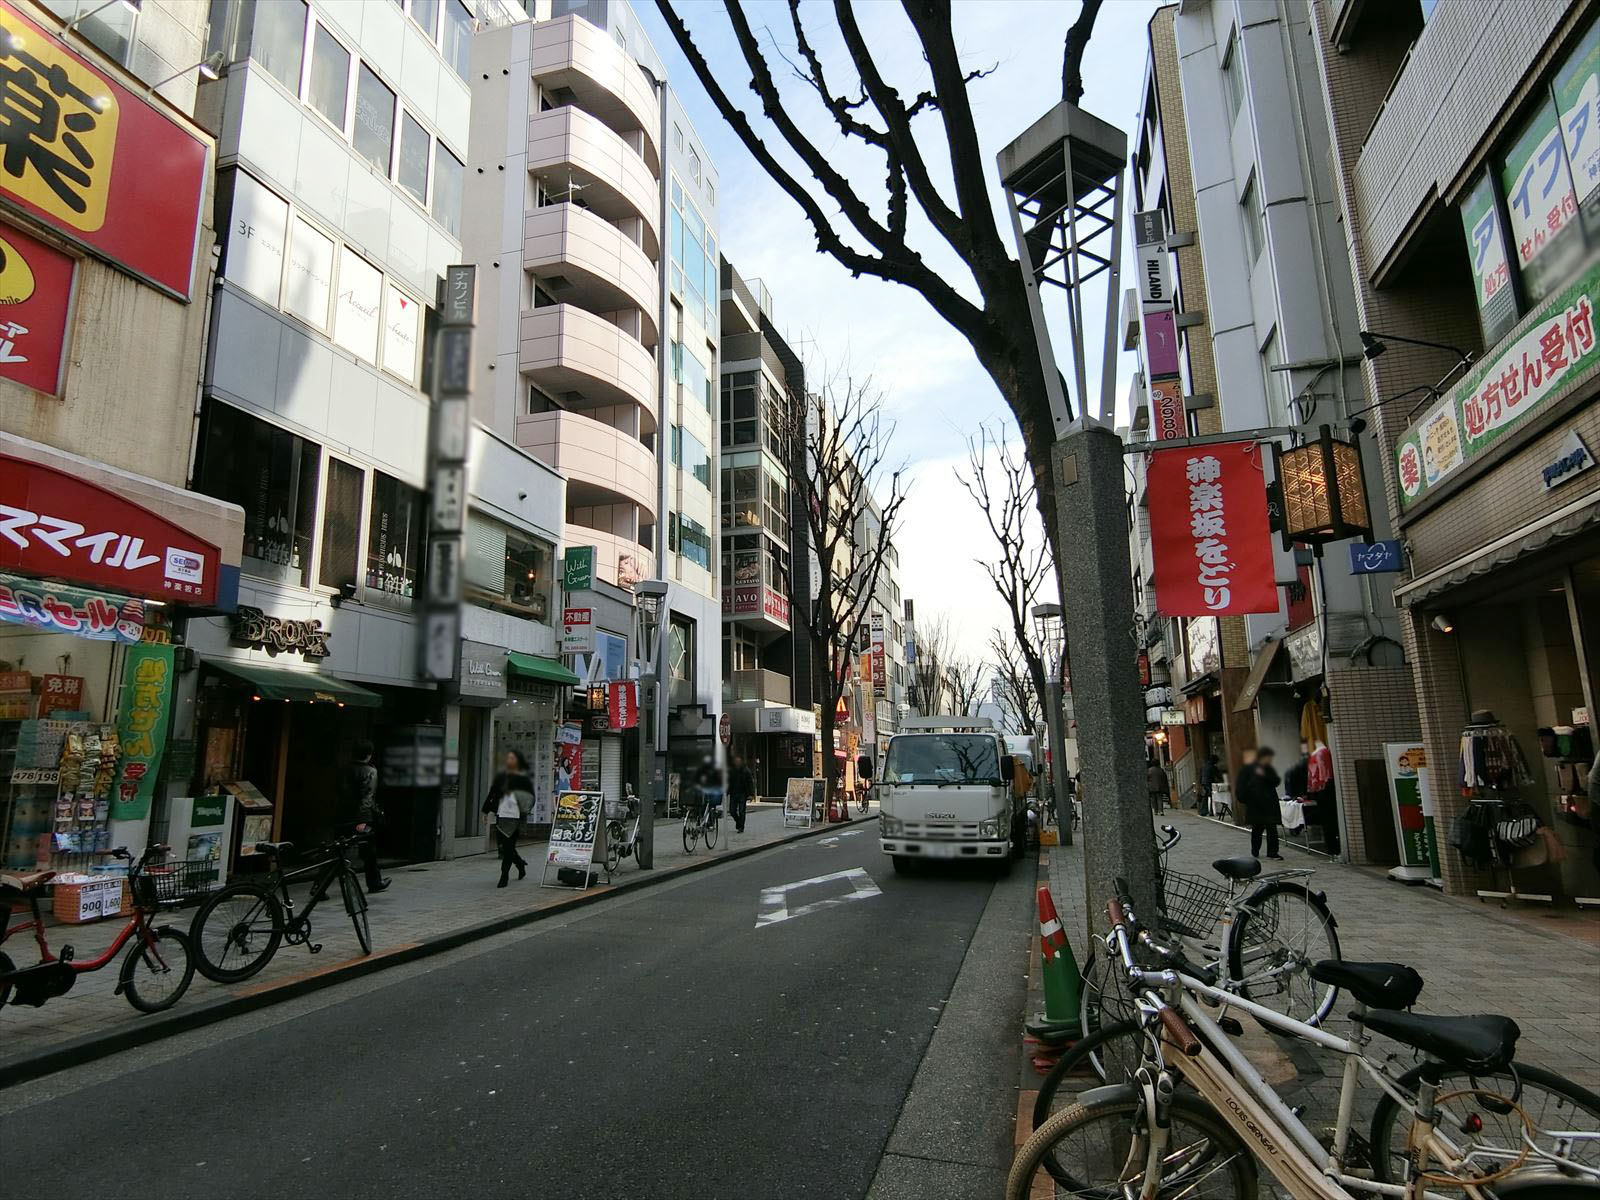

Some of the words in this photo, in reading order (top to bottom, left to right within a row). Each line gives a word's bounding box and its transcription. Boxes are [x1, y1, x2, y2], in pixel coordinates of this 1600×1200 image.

[238, 219, 255, 239] 3F
[1147, 259, 1163, 300] HILAND
[454, 270, 469, 319] ナカノビル
[1464, 299, 1594, 440] 処方せん受付
[1161, 397, 1178, 442] 2980
[1401, 448, 1420, 492] 薬
[1186, 455, 1237, 611] 神楽坂をどり
[1357, 550, 1392, 562] ヤマダヤ
[565, 612, 590, 622] 不動産
[47, 678, 79, 694] 免税
[14, 772, 34, 780] 478
[37, 772, 58, 782] 198
[82, 900, 101, 913] 900
[1225, 1097, 1248, 1122] LOUIS
